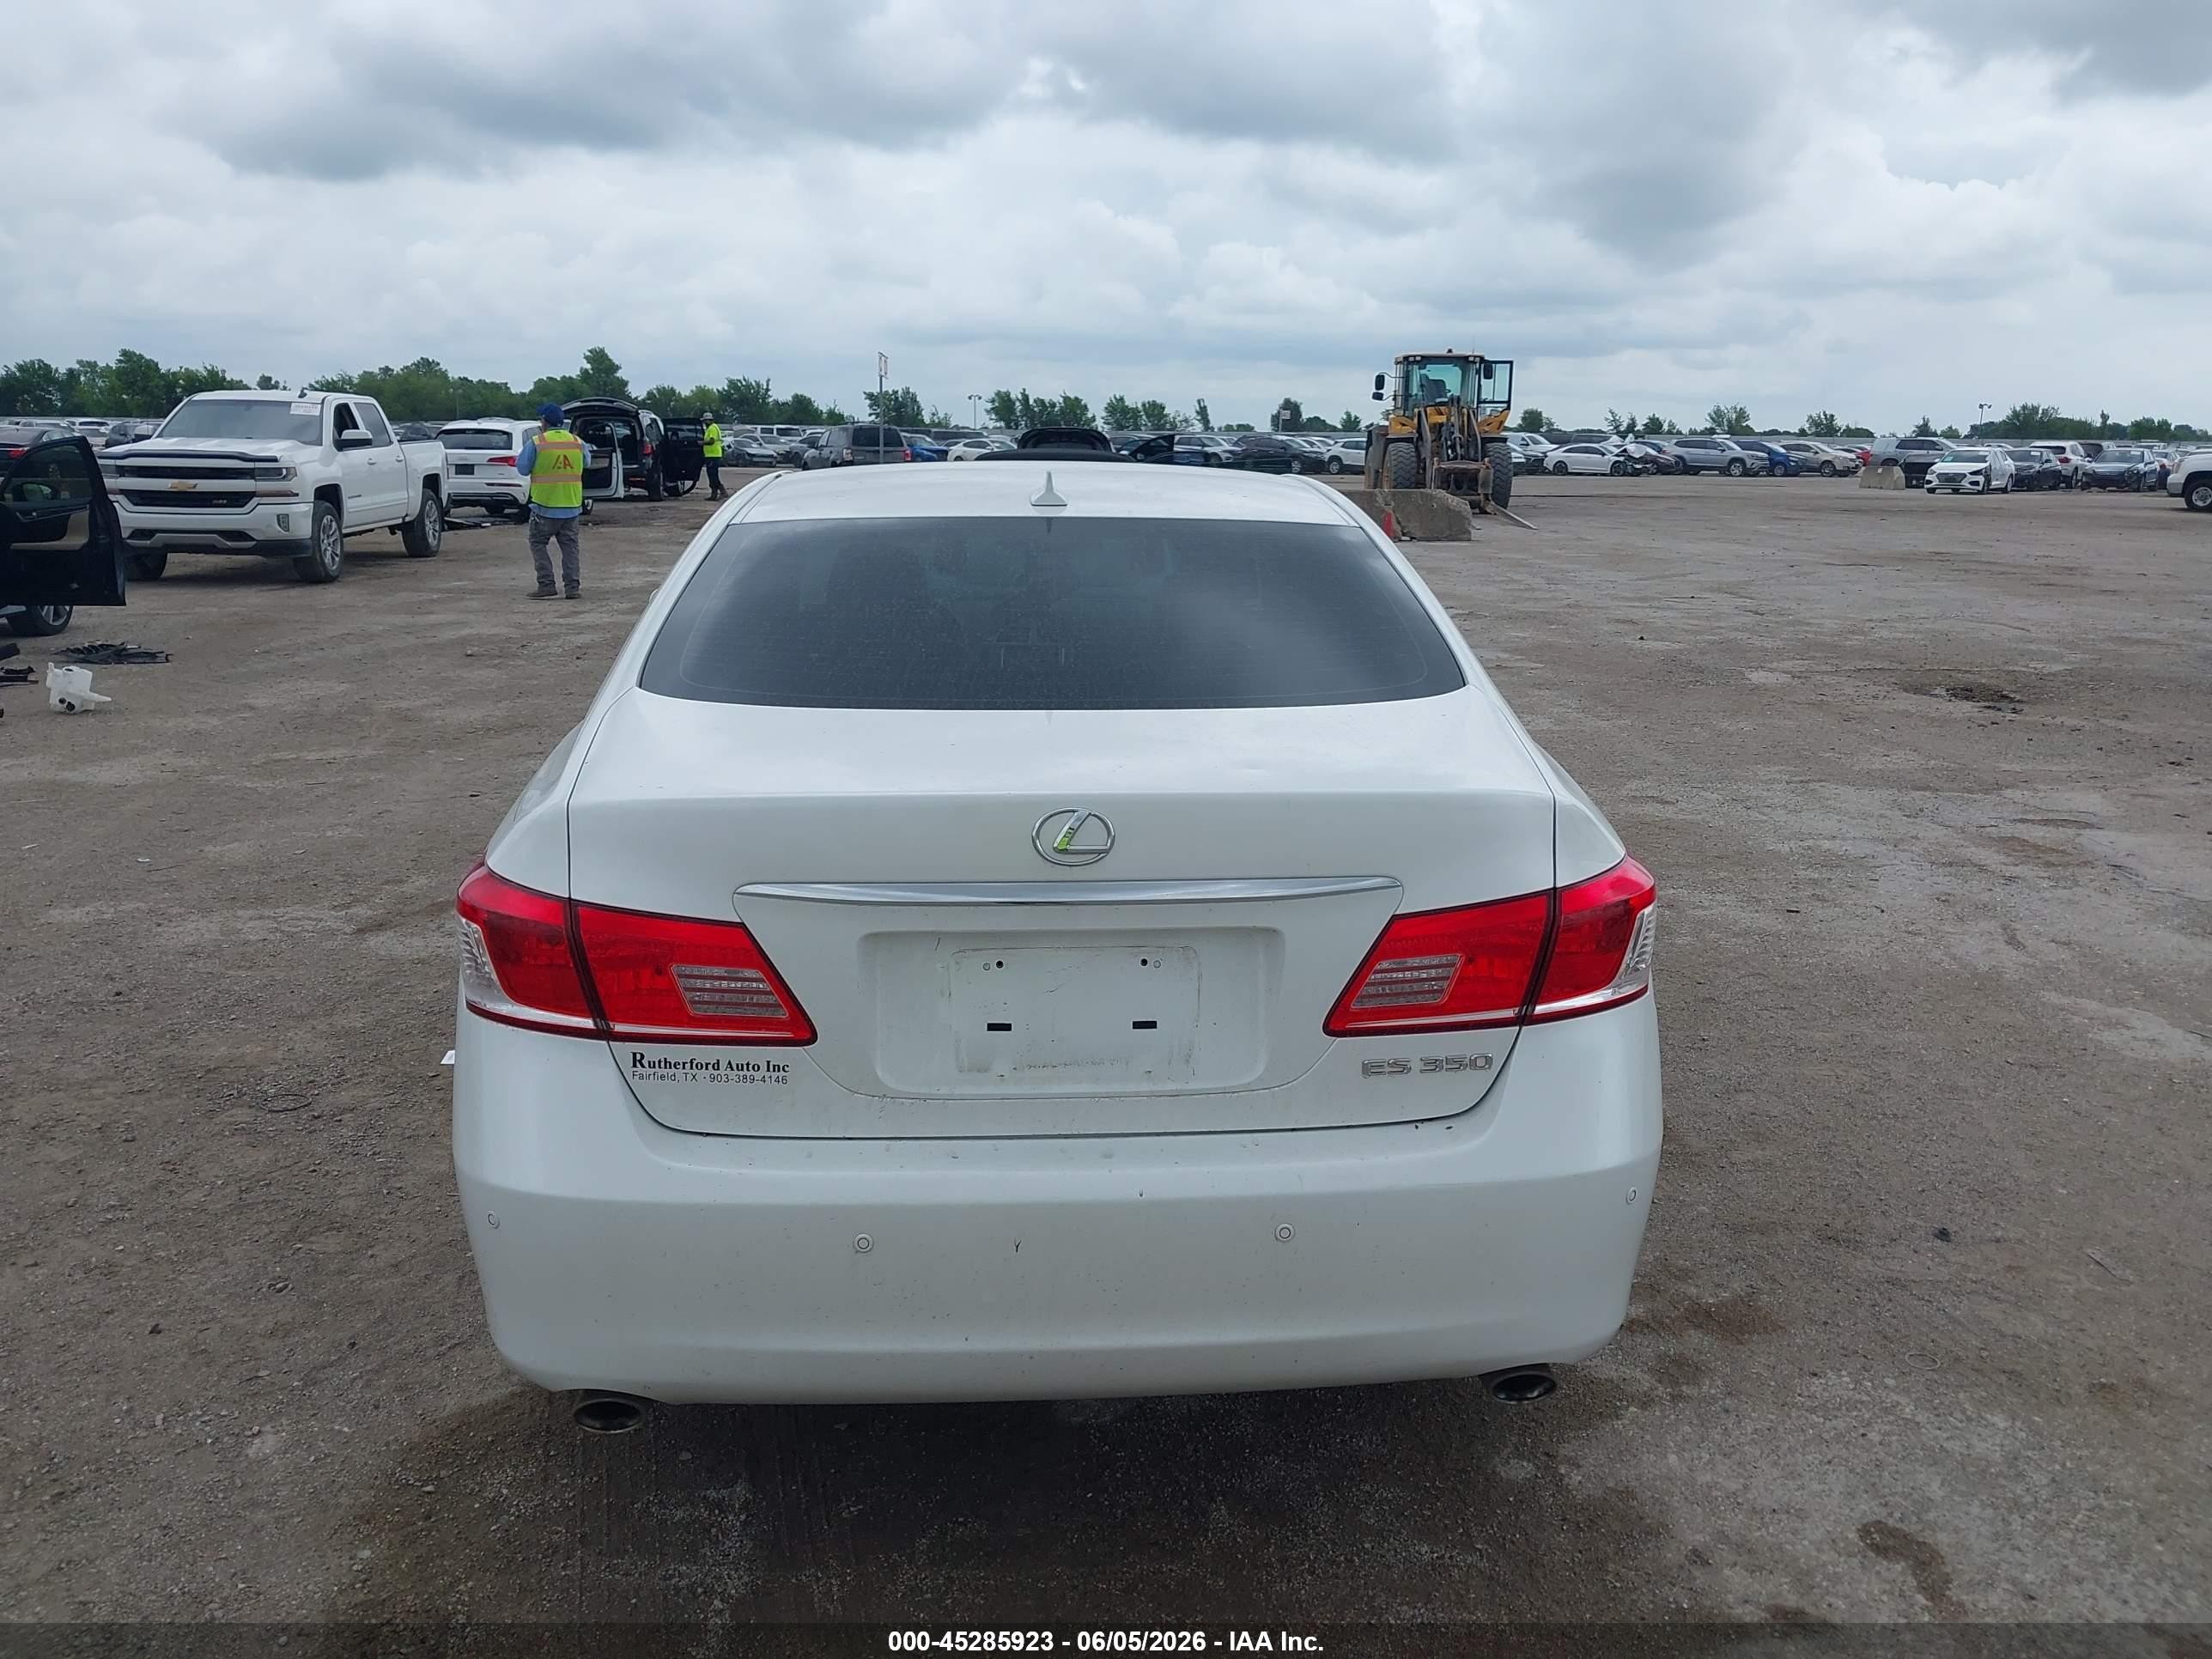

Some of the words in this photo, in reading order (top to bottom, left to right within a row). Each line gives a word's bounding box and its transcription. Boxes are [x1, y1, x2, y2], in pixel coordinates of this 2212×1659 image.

[630, 1051, 720, 1071] Rutherford
[725, 1060, 761, 1073] Auto
[766, 1060, 790, 1073] Inc
[1361, 1057, 1413, 1079] ES
[1419, 1052, 1494, 1074] 350
[632, 1071, 680, 1083] Fairfield,
[684, 1072, 698, 1083] TX
[709, 1073, 788, 1085] 903-389-4146
